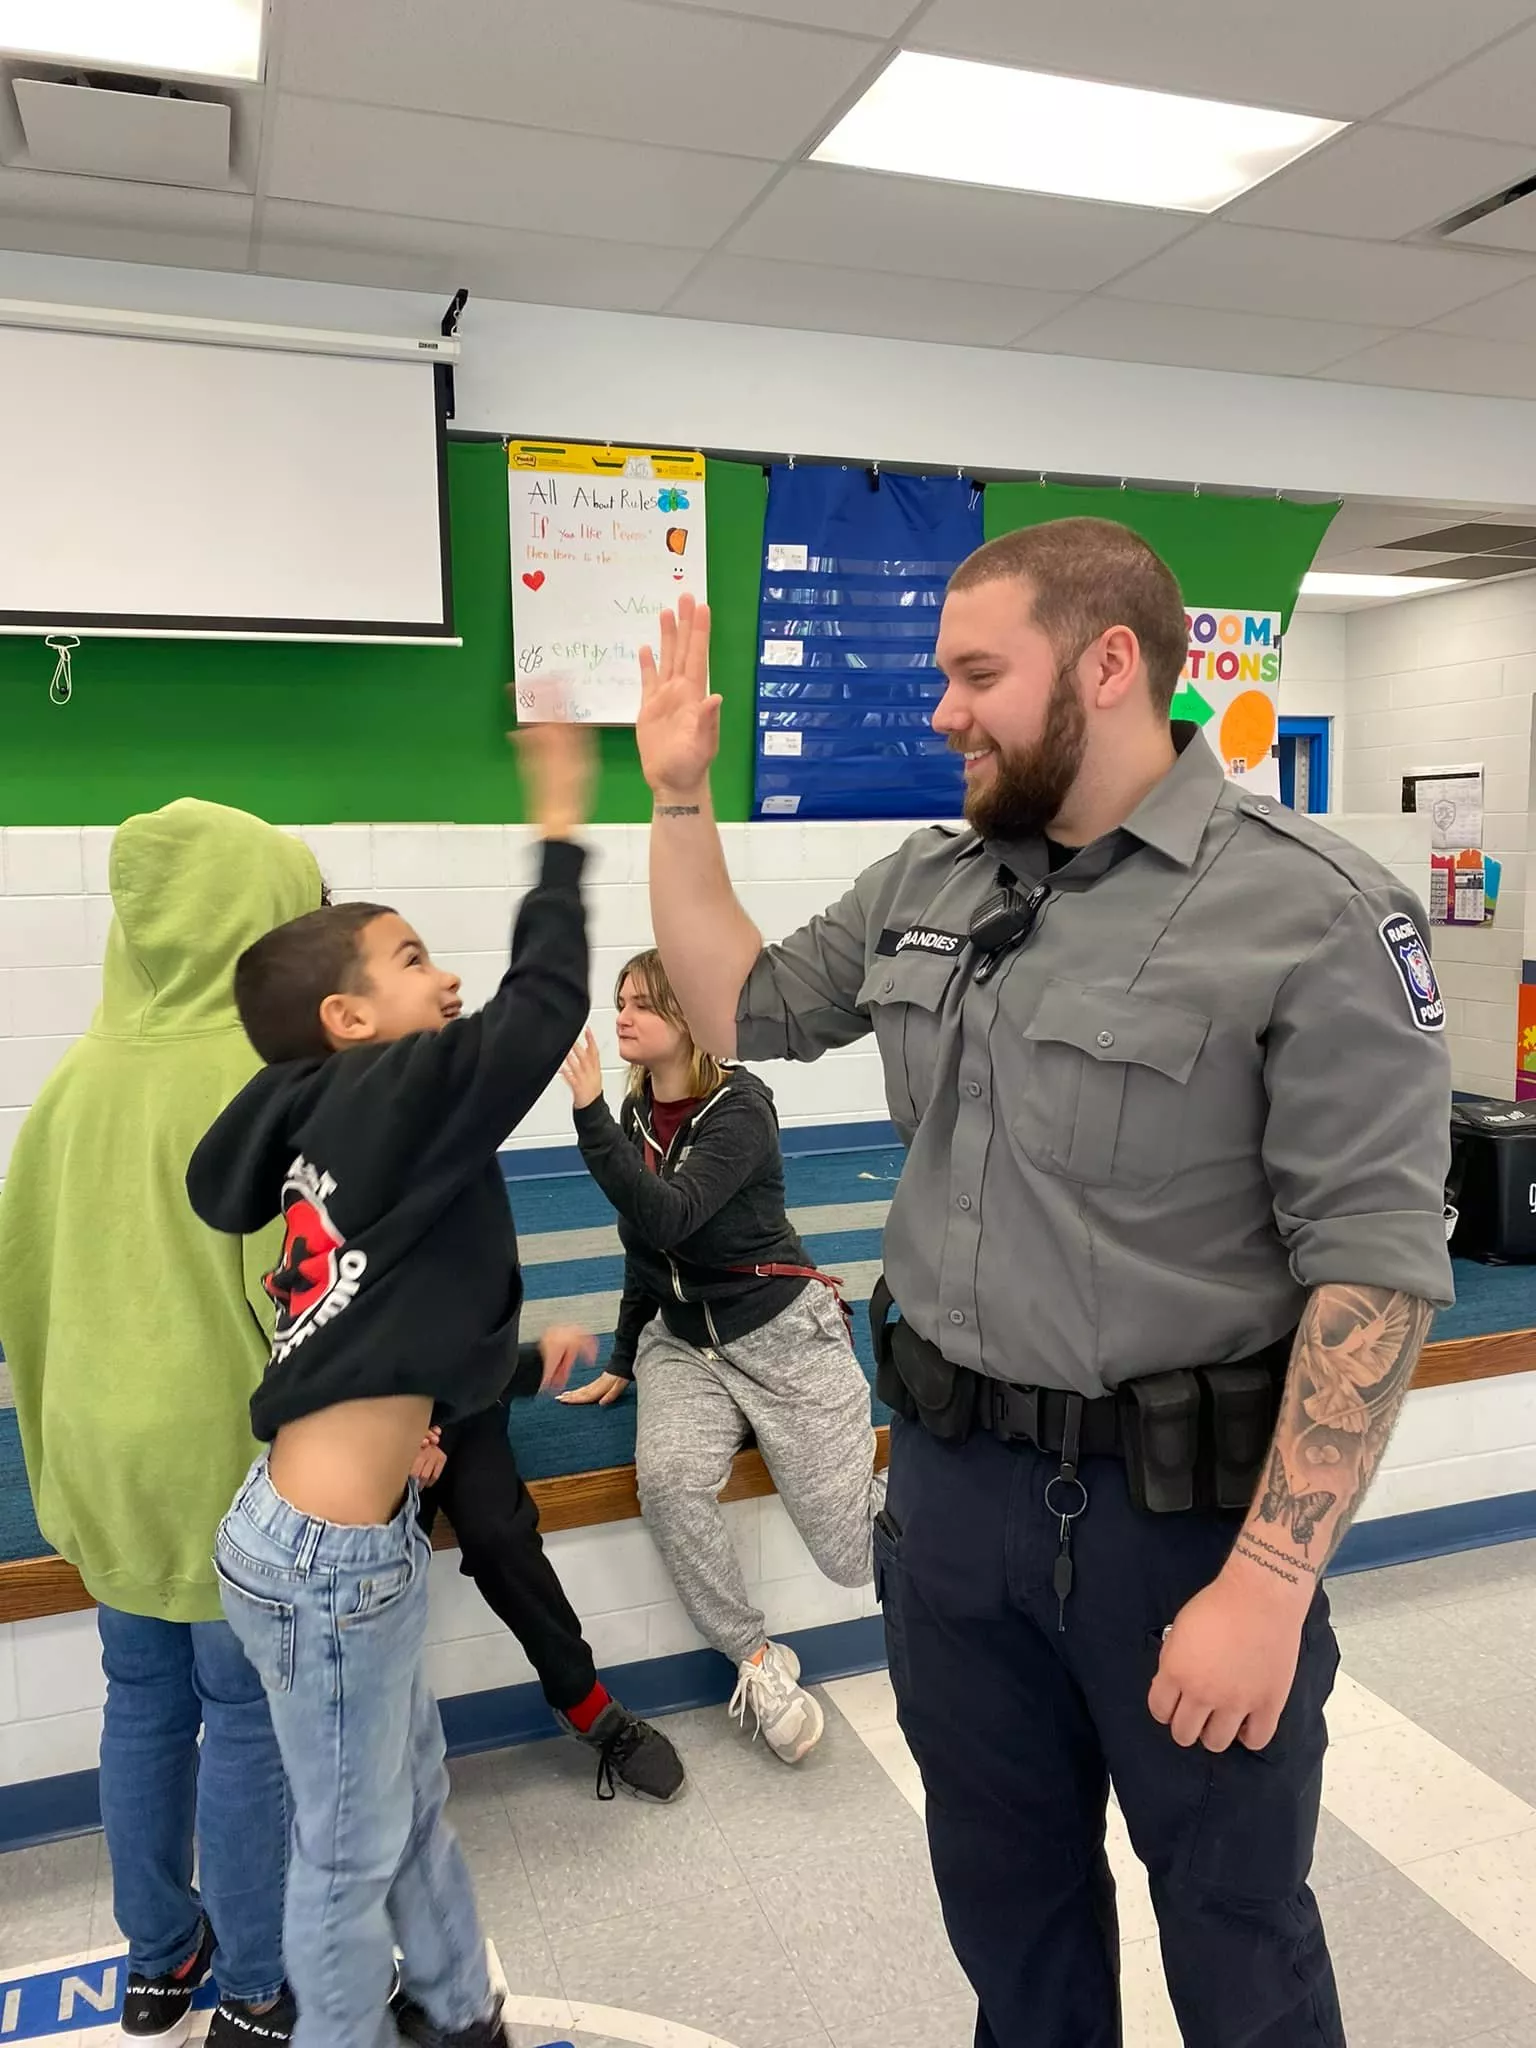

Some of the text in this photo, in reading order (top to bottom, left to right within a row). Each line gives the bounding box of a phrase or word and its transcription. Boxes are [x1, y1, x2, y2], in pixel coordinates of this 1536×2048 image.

[528, 480, 658, 511] All About Rules
[530, 511, 550, 540] If
[580, 523, 602, 540] like
[551, 642, 608, 671] energy
